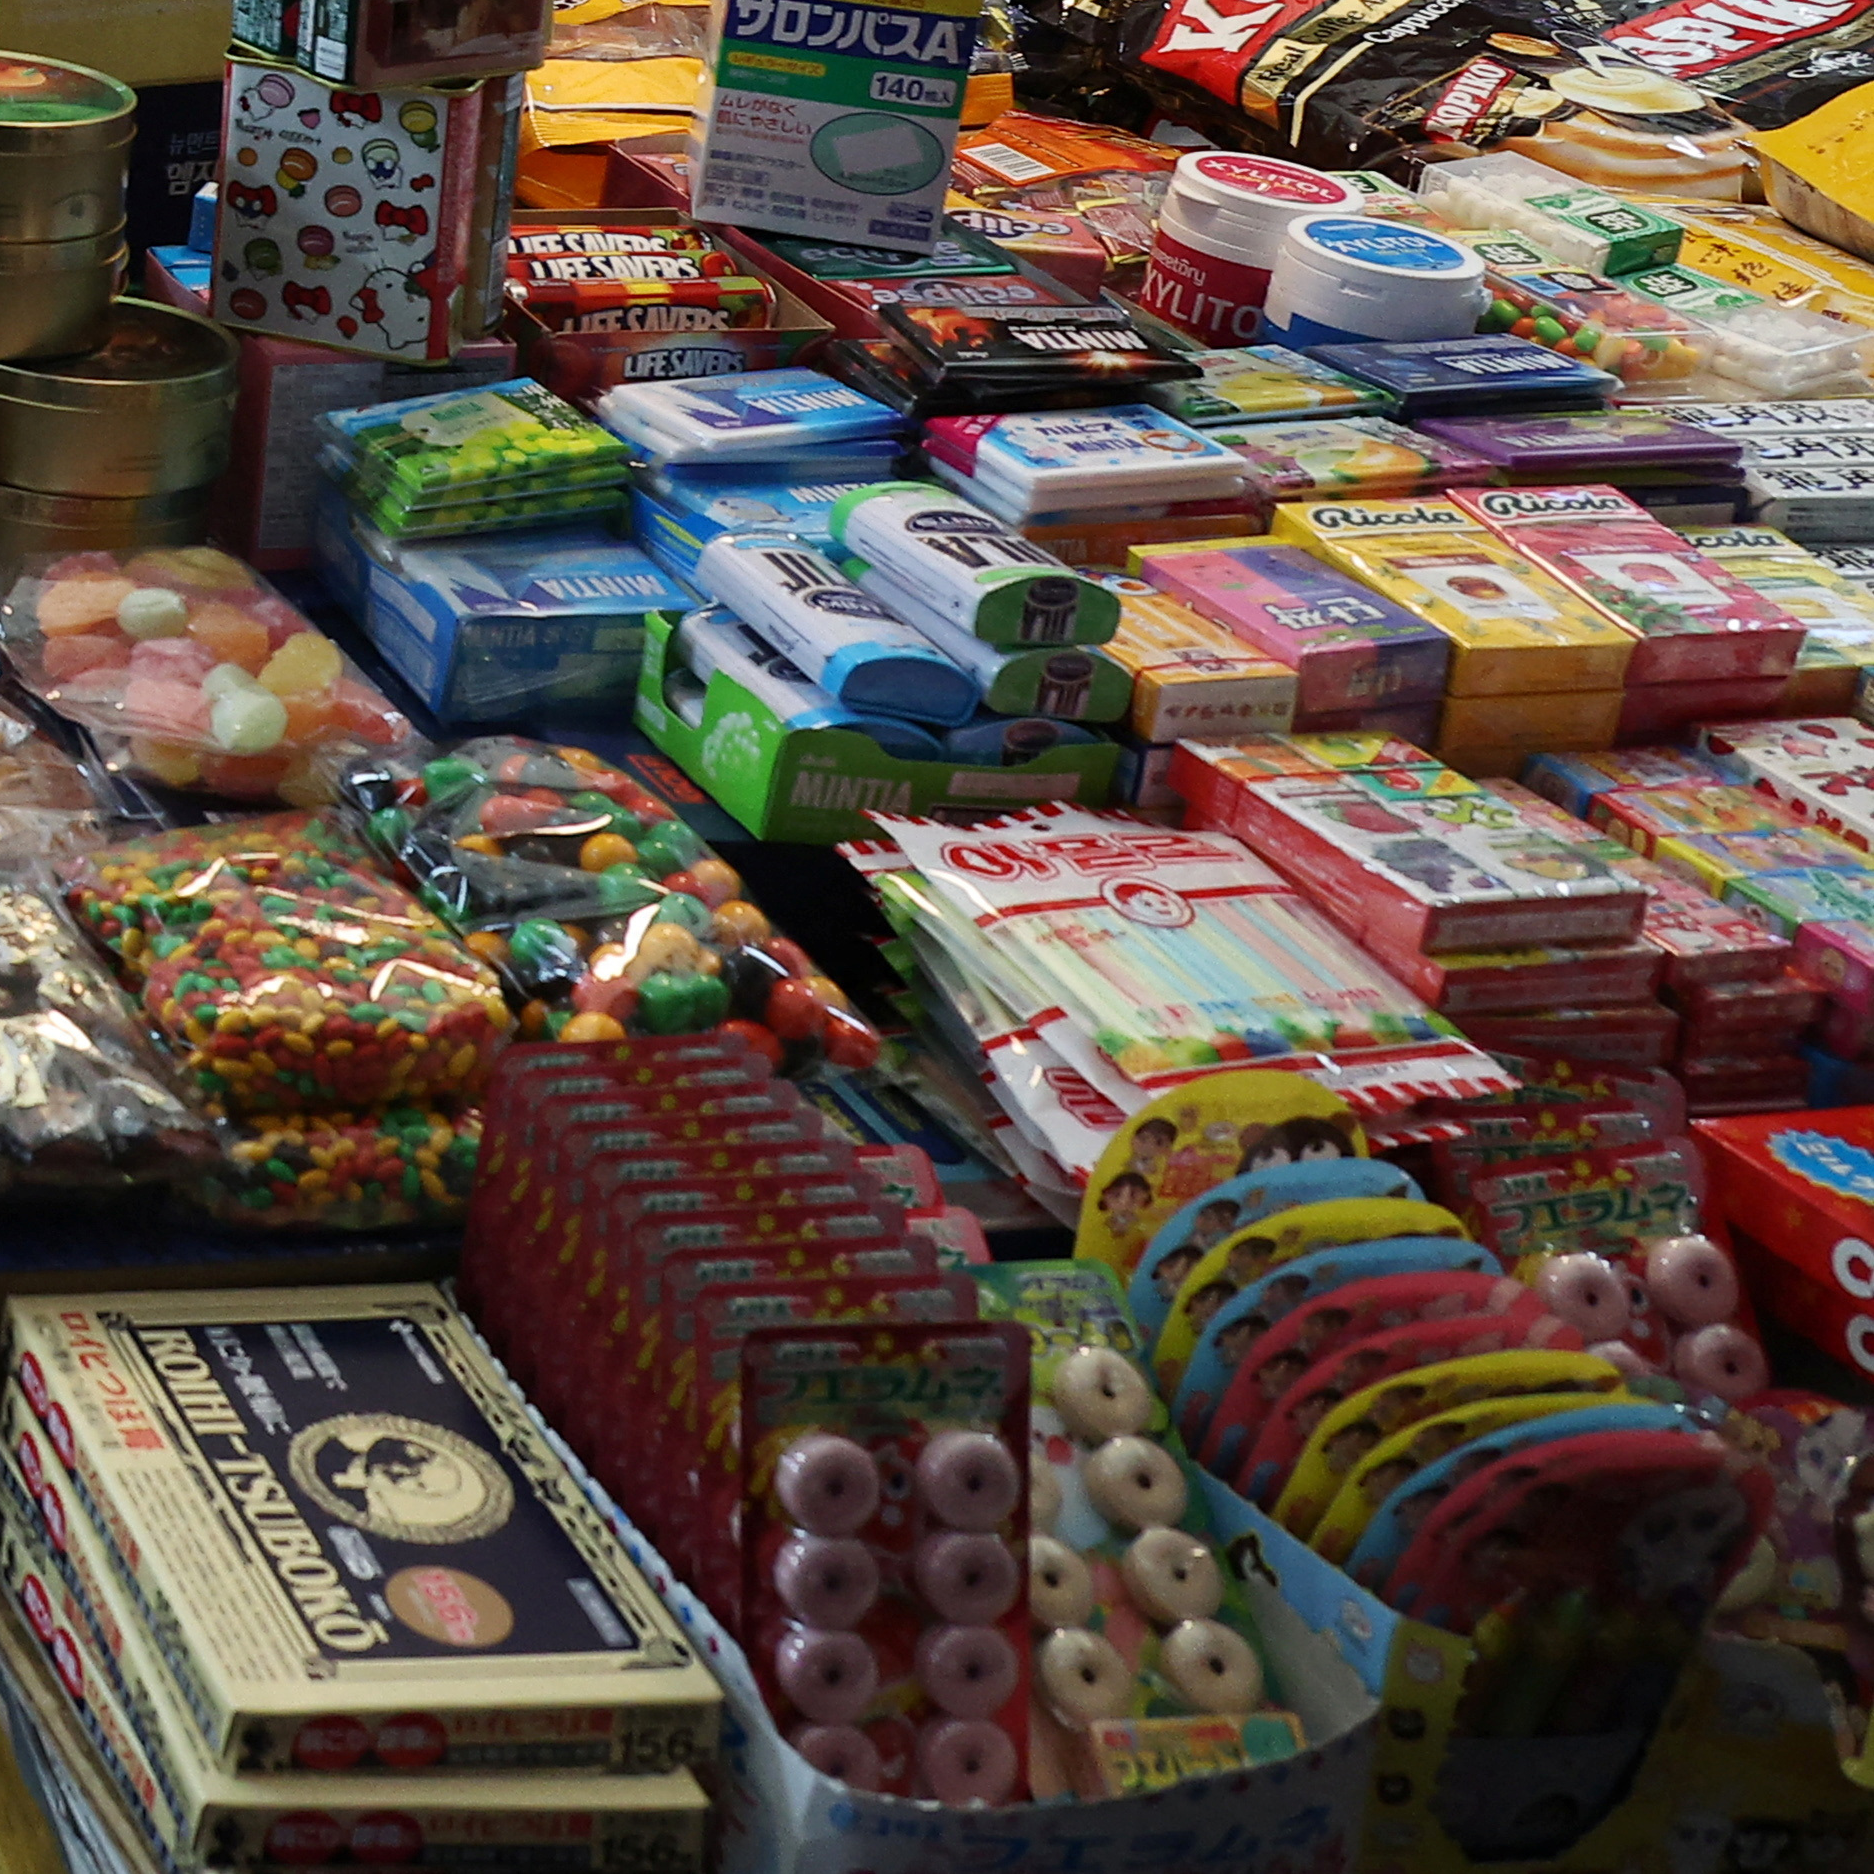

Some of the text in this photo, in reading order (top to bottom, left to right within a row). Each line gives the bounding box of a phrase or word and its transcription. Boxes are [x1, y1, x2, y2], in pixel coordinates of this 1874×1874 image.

[719, 93, 798, 118] ムレがなく
[1204, 157, 1339, 203] XYLITOL
[530, 253, 701, 281] LIFE SAVERS
[1008, 326, 1149, 352] MINTIA
[623, 347, 747, 378] LIFE SAVERS
[1446, 352, 1576, 375] MINTIA
[741, 387, 868, 416] MINTIA
[1482, 489, 1631, 517] Ricola
[1312, 506, 1464, 531] Ricola
[537, 574, 669, 600] MINTIA
